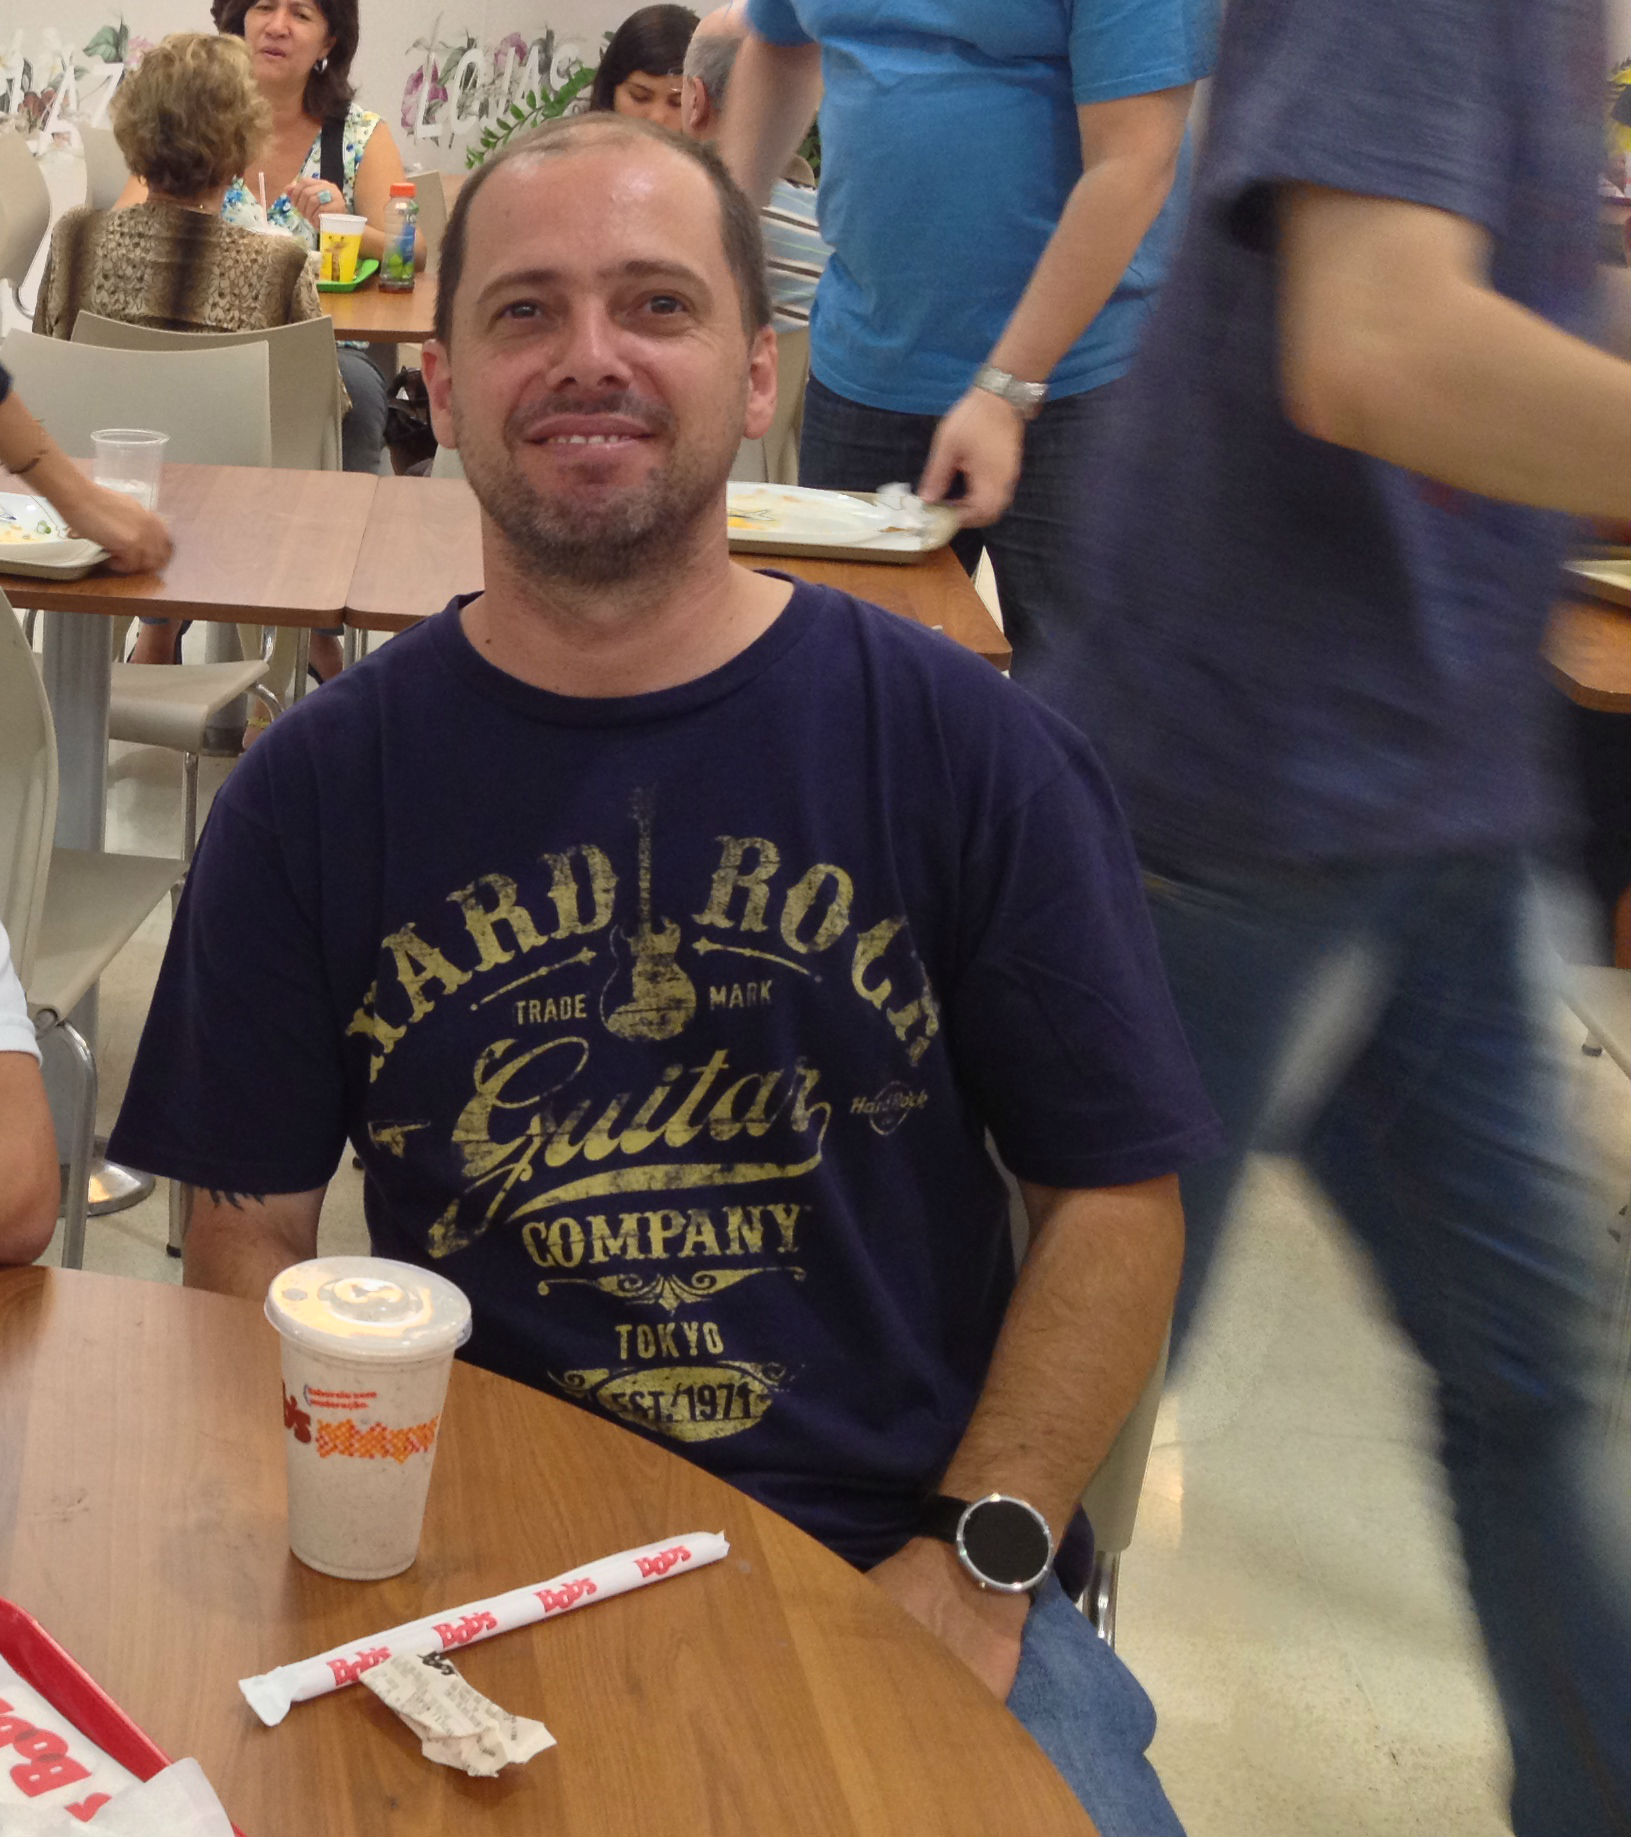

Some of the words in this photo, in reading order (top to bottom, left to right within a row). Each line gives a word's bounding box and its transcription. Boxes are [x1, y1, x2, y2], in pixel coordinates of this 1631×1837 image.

[514, 995, 588, 1026] TRADE
[709, 980, 773, 1011] MARK
[429, 1036, 831, 1250] Guitar
[521, 1204, 811, 1269] COMPANY
[615, 1322, 724, 1361] TOKYO
[633, 1544, 692, 1580] Bob's
[532, 1576, 598, 1614] Bob's
[432, 1609, 498, 1650] Bob's
